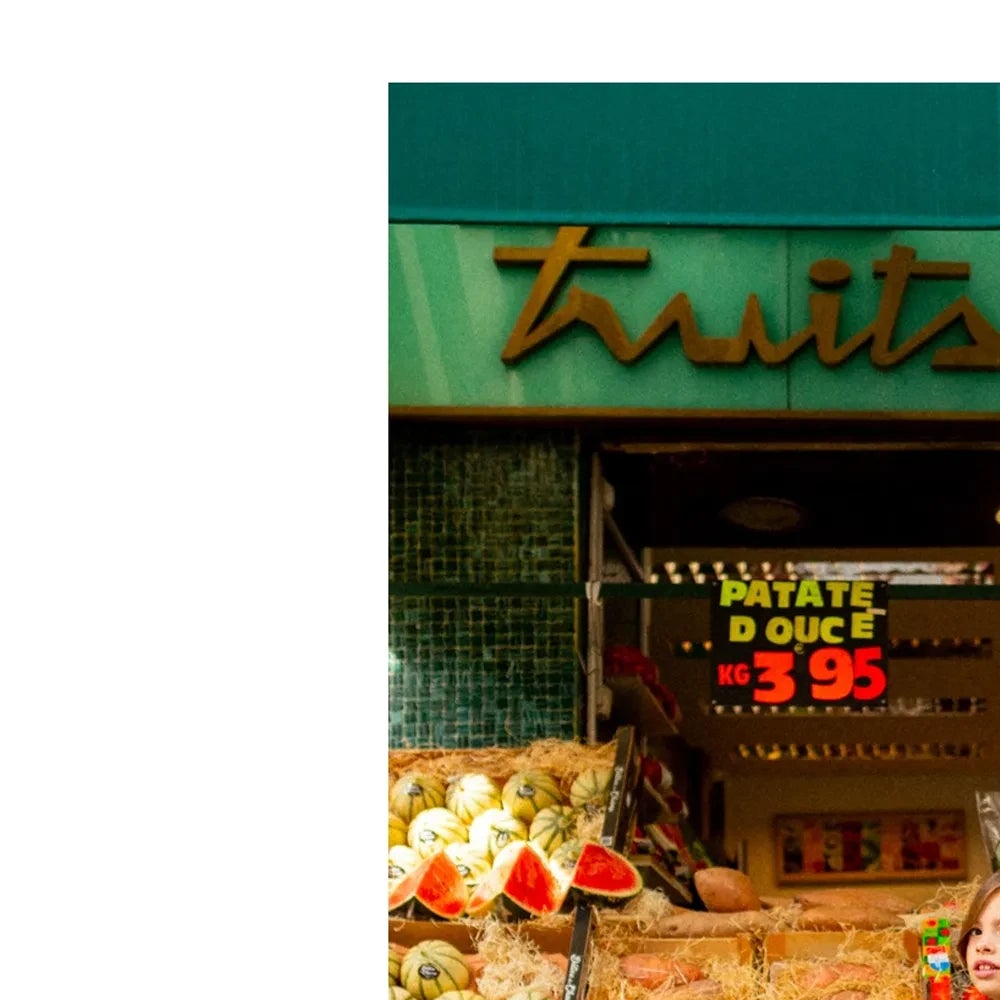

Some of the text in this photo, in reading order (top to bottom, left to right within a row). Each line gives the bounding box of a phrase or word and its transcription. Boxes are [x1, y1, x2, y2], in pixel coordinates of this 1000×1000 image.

[719, 579, 875, 608] PATATE
[729, 612, 875, 645] DOUCE
[717, 663, 751, 686] KG
